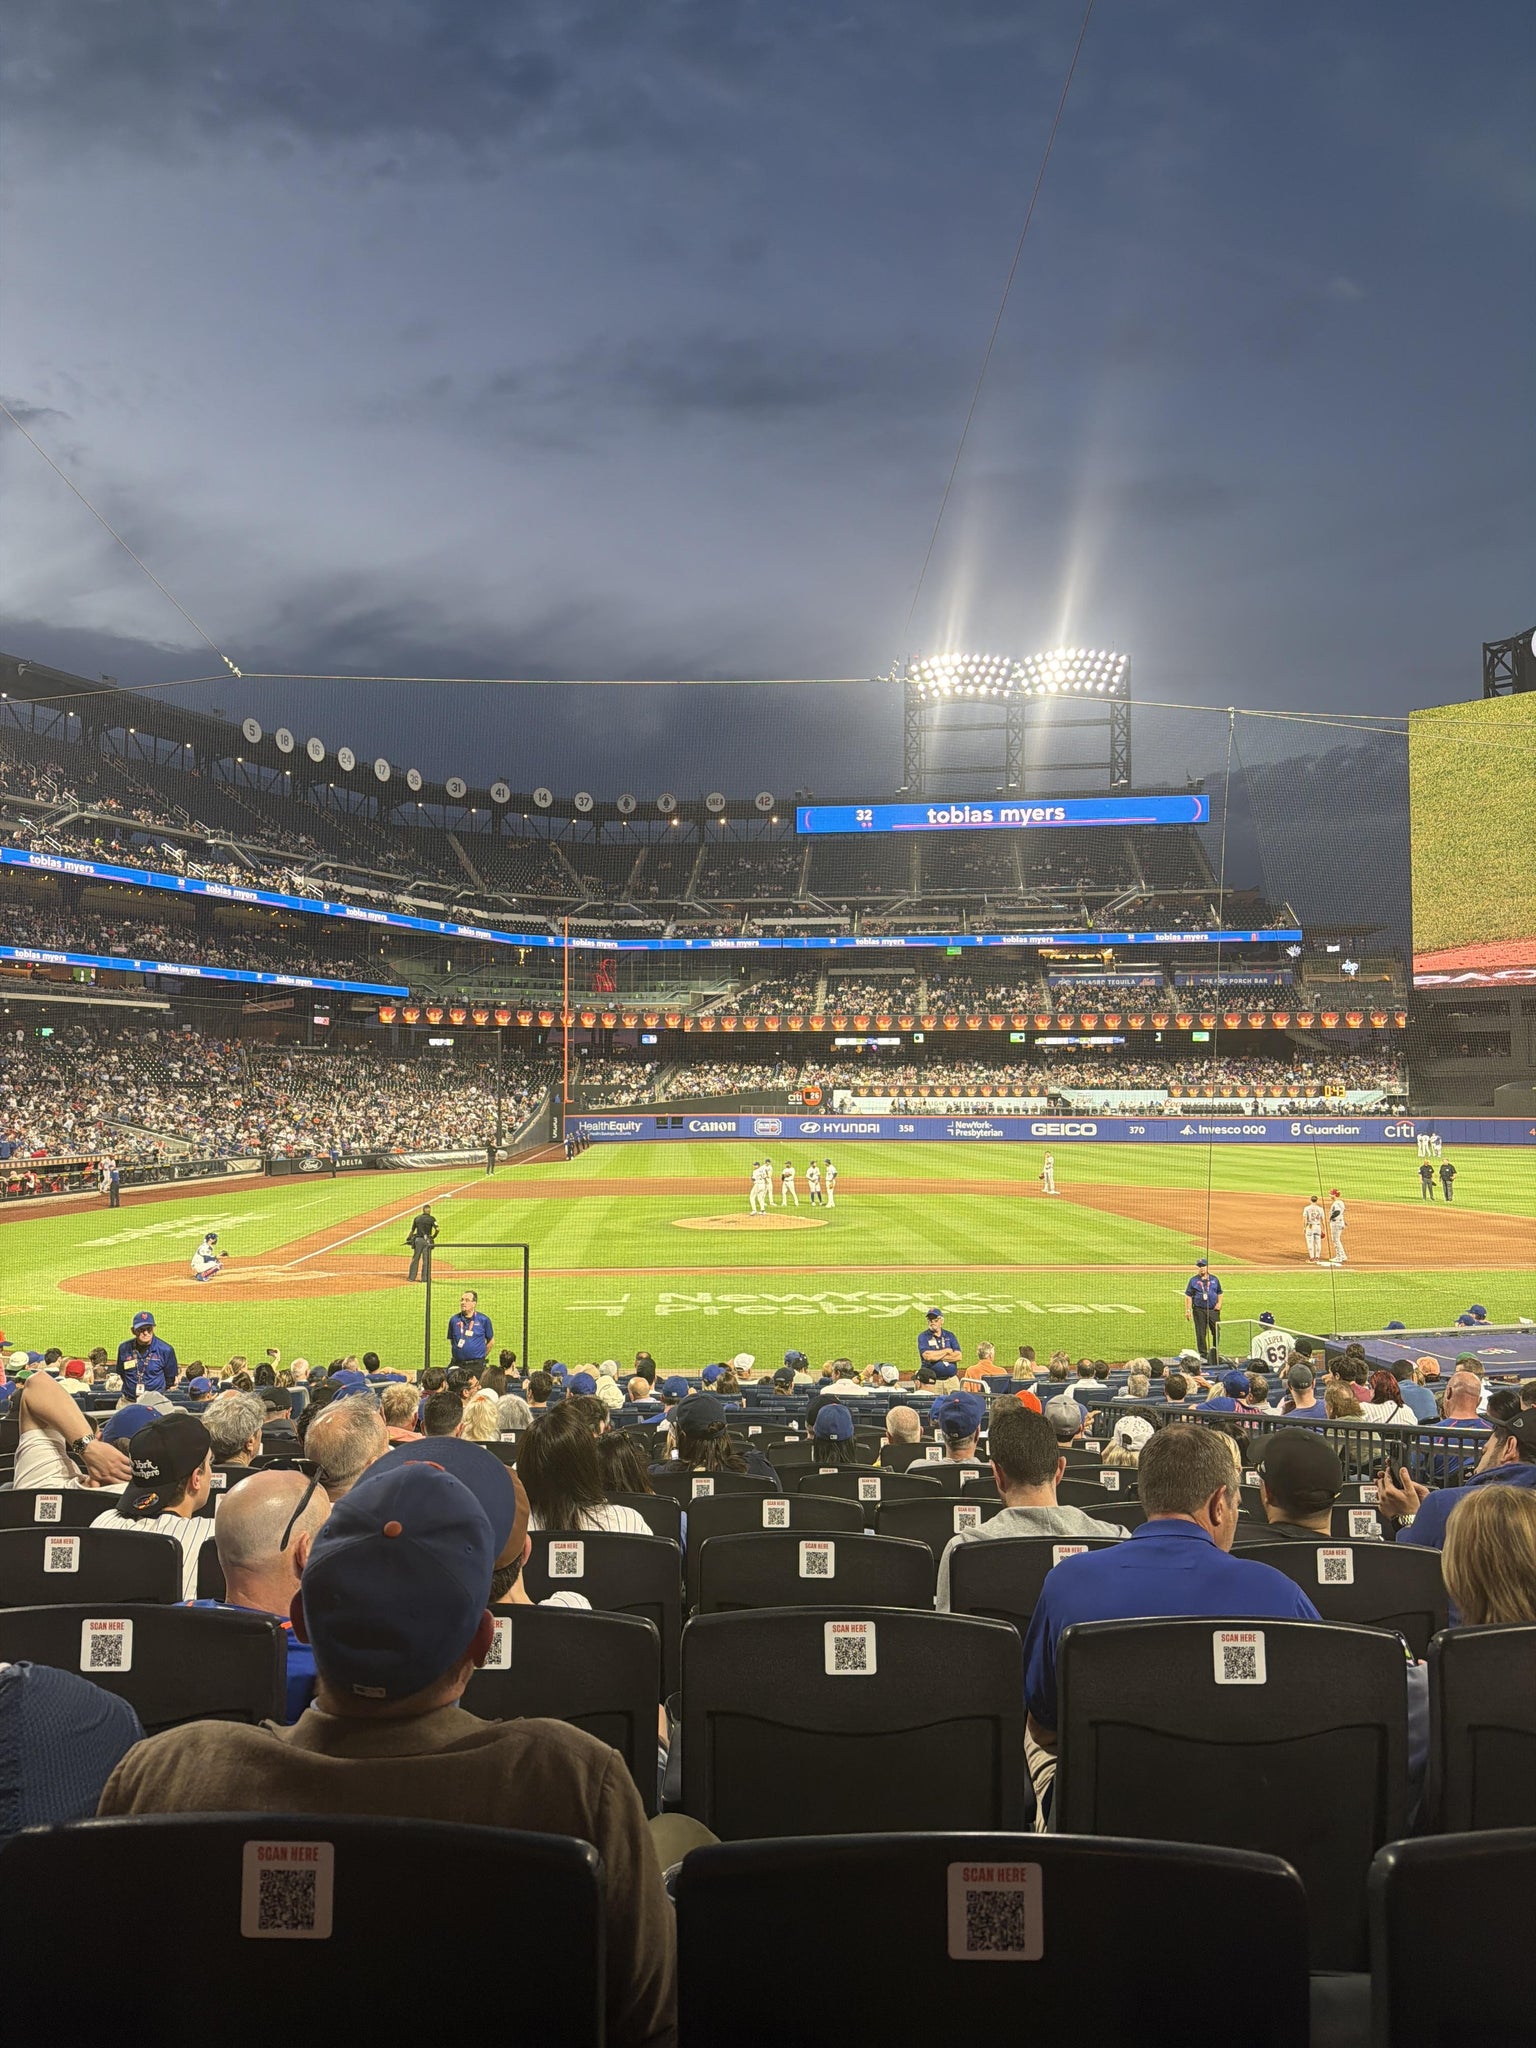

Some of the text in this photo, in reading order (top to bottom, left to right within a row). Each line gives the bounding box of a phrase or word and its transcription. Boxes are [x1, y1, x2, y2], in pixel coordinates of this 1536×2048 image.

[250, 725, 256, 737] 5
[280, 734, 289, 746] 18
[312, 744, 320, 756] 16
[342, 752, 351, 764] 24
[379, 765, 386, 775] 17
[409, 775, 418, 785] 36
[452, 782, 461, 792] 31
[496, 788, 505, 798] 41
[538, 793, 547, 802] 14
[579, 797, 589, 807] 37
[758, 797, 770, 806] 42
[856, 810, 872, 821] 32
[927, 806, 1066, 826] tobias myers
[29, 854, 94, 873] tobias myers
[206, 884, 257, 900] tobias myers
[1155, 933, 1181, 941] tobias
[15, 950, 66, 962] tobias myers
[579, 1121, 641, 1132] HealthEquity
[689, 1120, 736, 1132] Canon
[823, 1123, 880, 1133] HYUNDAI
[1031, 1123, 1097, 1136] GEICO
[1129, 1126, 1145, 1134] 370
[1199, 1125, 1266, 1135] Invesco QQQ
[1304, 1124, 1360, 1135] Guardian
[1384, 1121, 1414, 1138] citi
[955, 1129, 1003, 1138] Presbyterian
[1267, 1345, 1286, 1363] 63
[90, 1622, 124, 1630] SCAN HERE
[832, 1624, 867, 1632] SCAN HERE
[258, 1846, 318, 1862] SCAN HERE
[963, 1867, 1026, 1882] SCAN HERE
